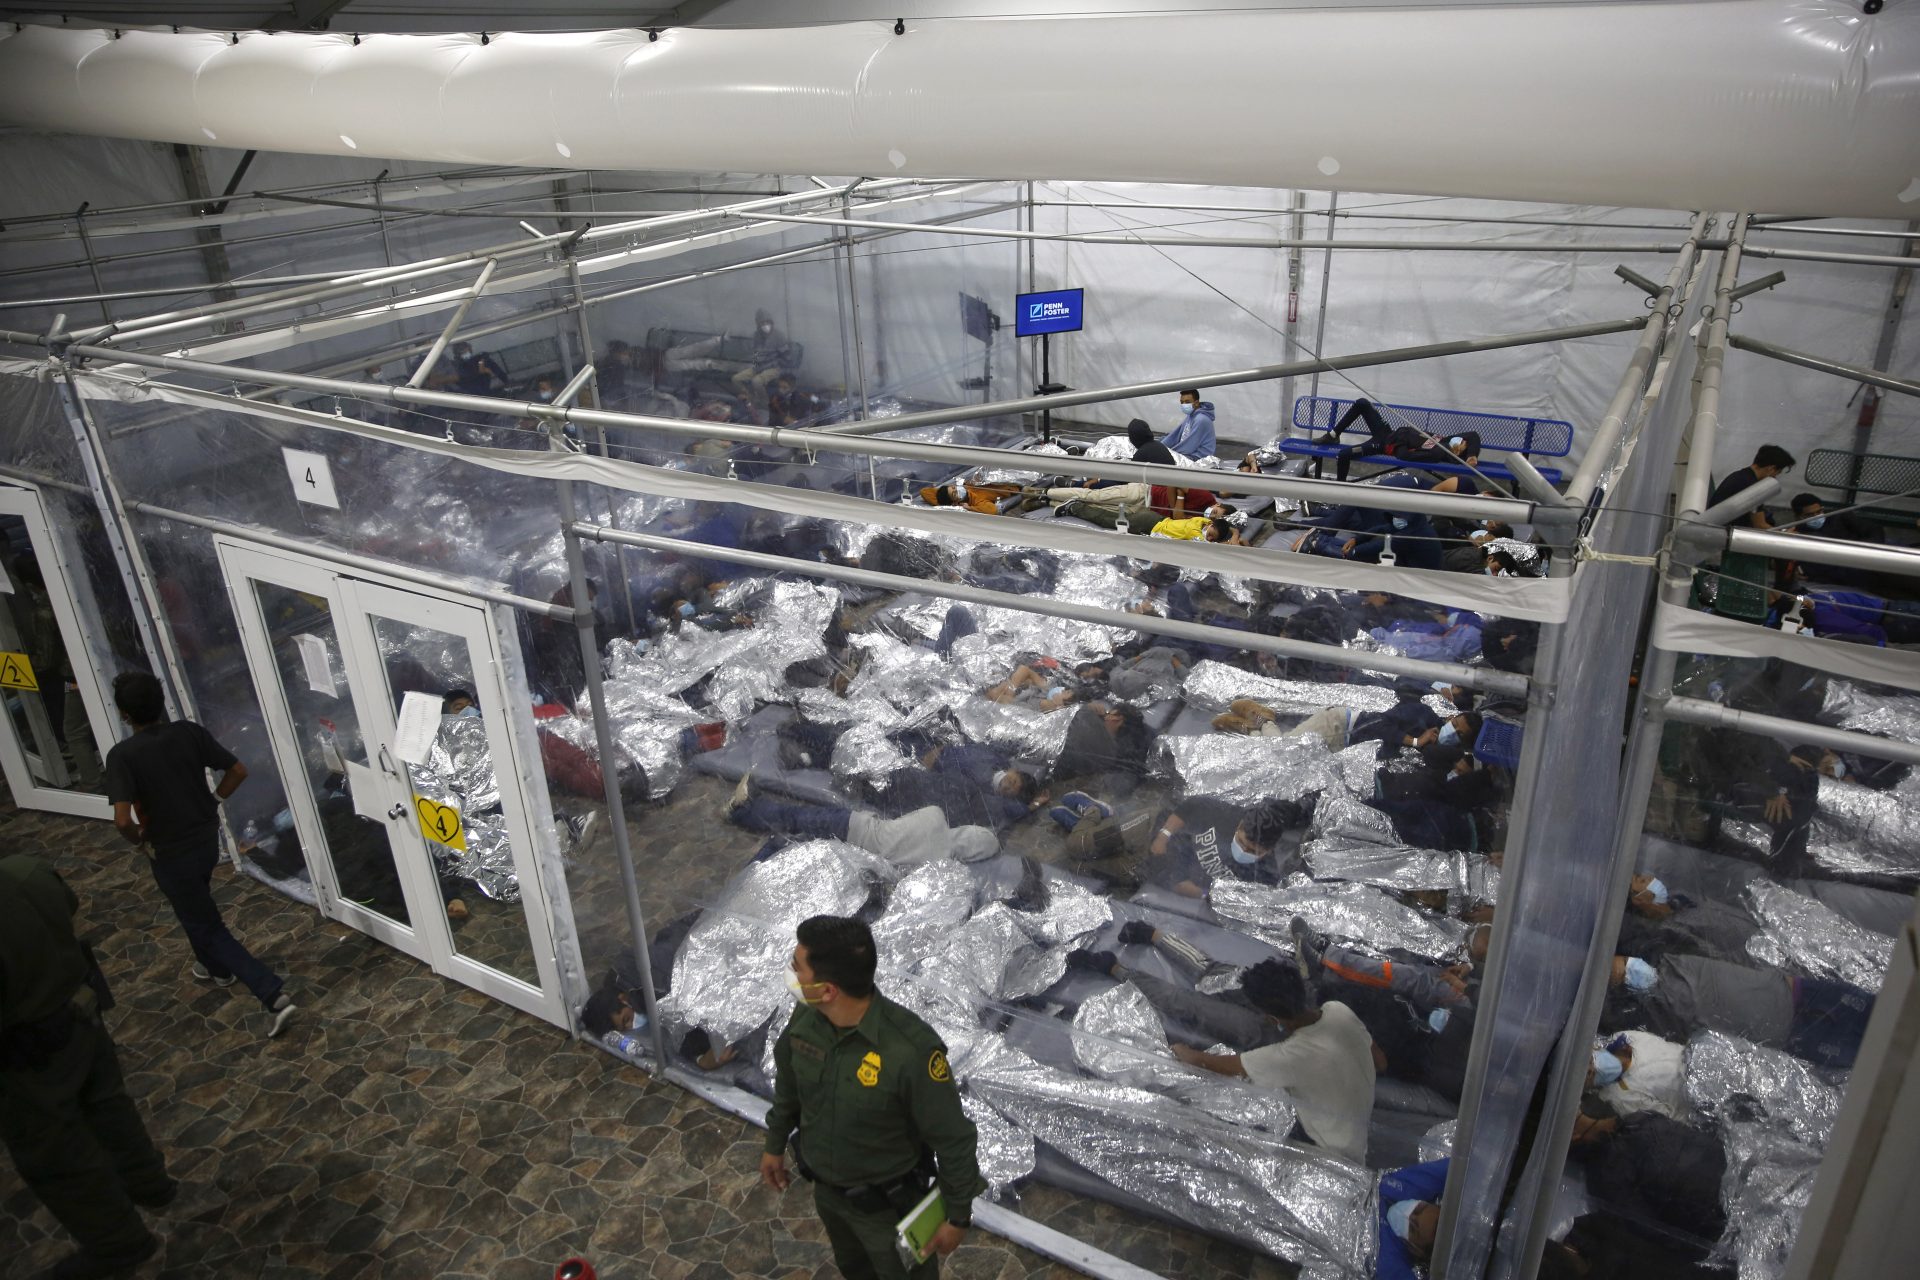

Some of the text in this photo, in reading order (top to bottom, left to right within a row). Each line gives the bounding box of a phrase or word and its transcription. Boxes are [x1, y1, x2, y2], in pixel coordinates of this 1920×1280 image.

[1044, 302, 1063, 310] PENN
[1044, 307, 1069, 316] FOSTER
[305, 467, 316, 488] 4
[8, 665, 21, 683] 2
[436, 815, 447, 836] 4
